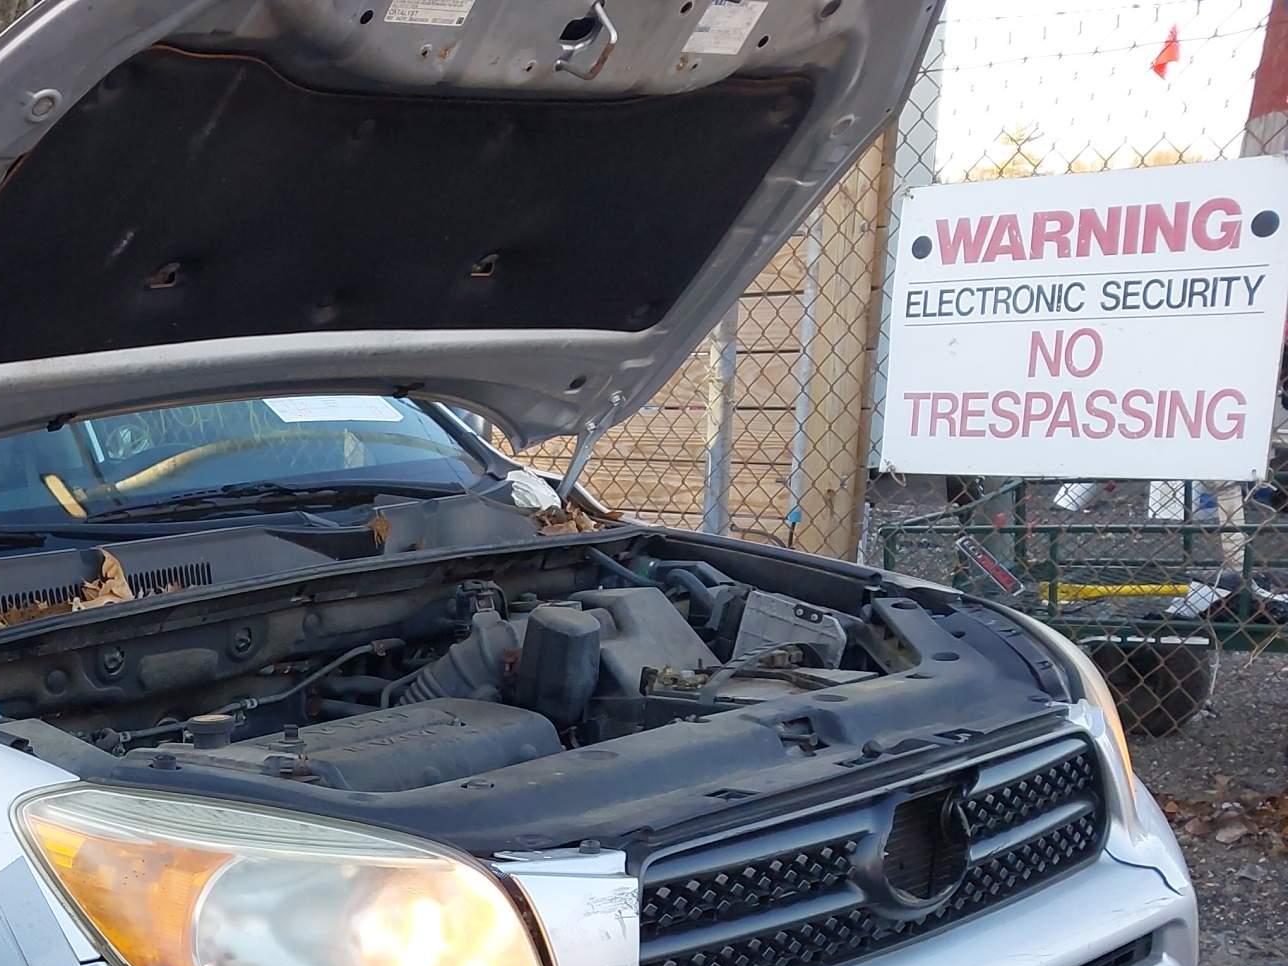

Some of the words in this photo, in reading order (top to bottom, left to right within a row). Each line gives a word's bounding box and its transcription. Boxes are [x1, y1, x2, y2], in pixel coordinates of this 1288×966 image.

[936, 197, 1243, 265] WARNING
[905, 282, 1086, 318] ELECTRONIC
[1100, 274, 1266, 311] SECURITY
[1027, 328, 1103, 378] NO
[903, 388, 1247, 441] TRESPASSING
